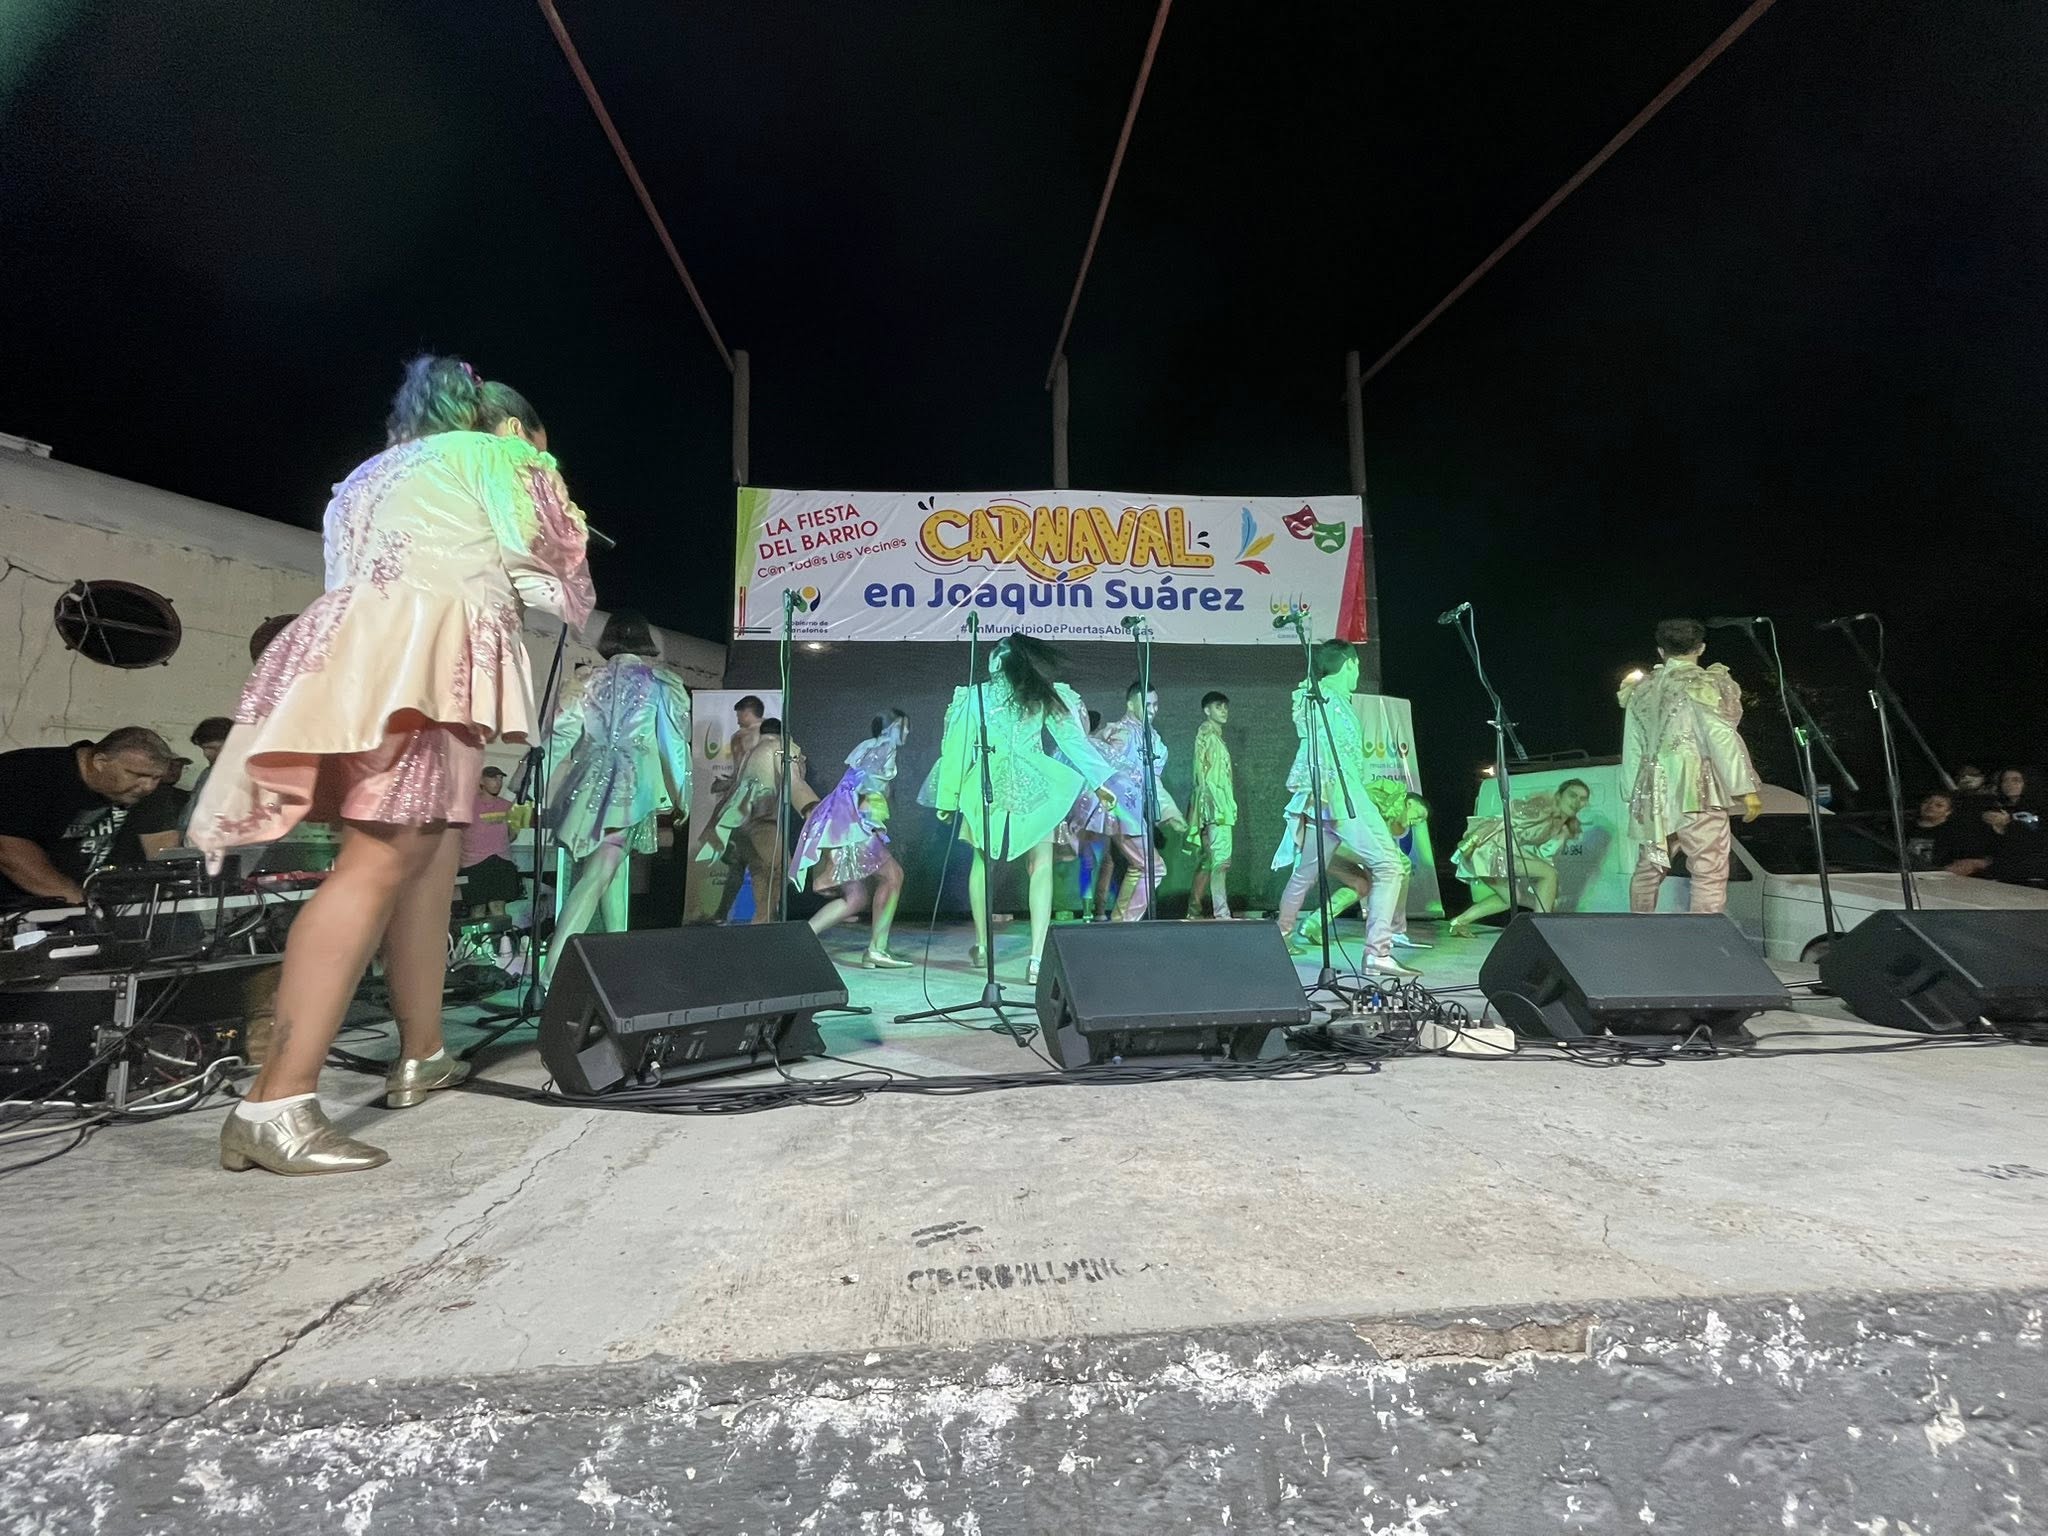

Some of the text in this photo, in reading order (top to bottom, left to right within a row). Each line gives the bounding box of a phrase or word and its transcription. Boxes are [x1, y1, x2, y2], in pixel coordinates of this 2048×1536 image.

[758, 520, 878, 560] DEL BARRIO
[765, 503, 861, 537] LA FIESTA
[757, 537, 908, 579] C@n Tod@s L@s Vecin@s
[918, 505, 1215, 580] CARNAVAL
[863, 571, 1245, 615] en Joaquín Suárez
